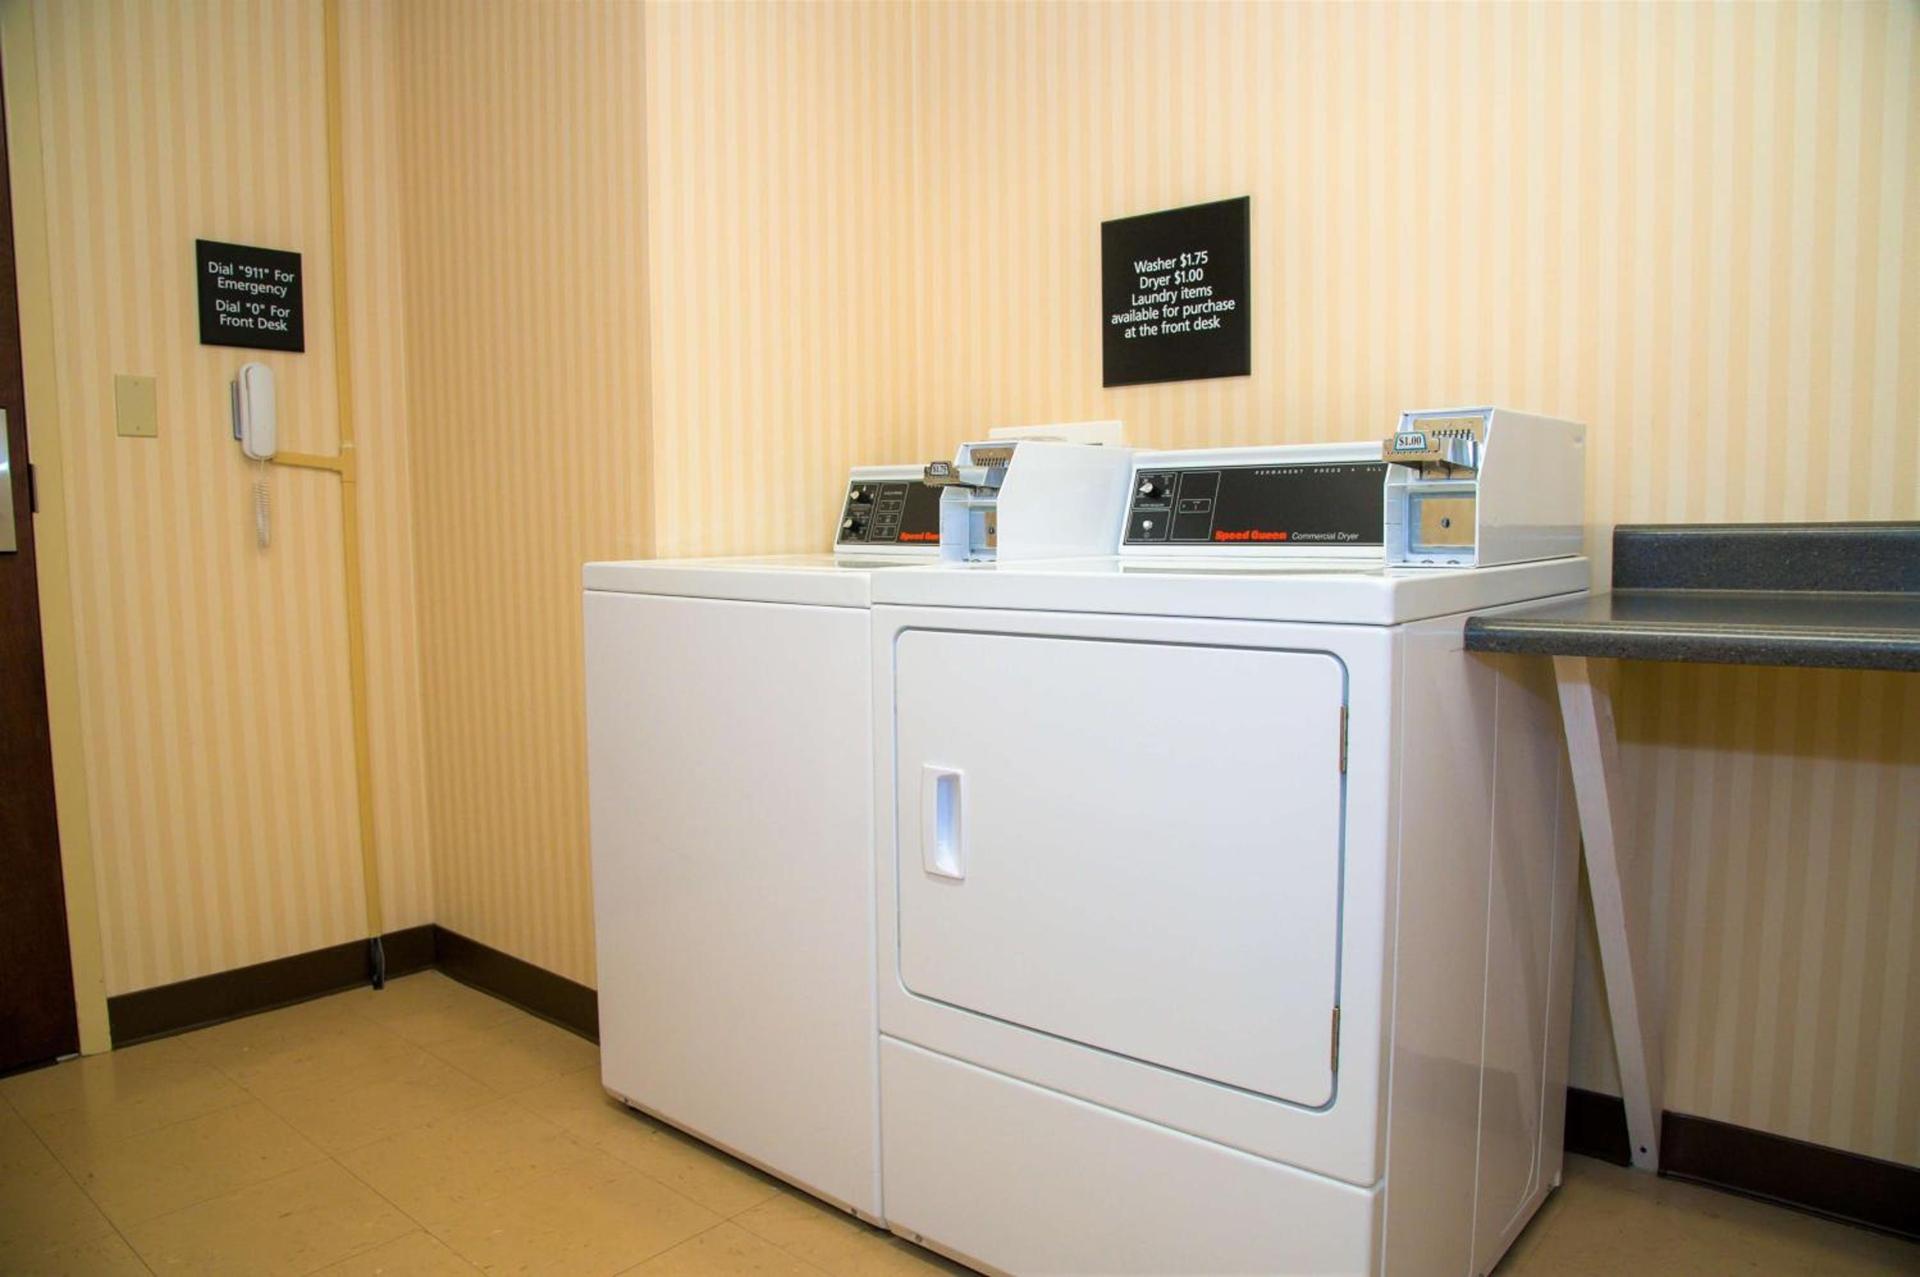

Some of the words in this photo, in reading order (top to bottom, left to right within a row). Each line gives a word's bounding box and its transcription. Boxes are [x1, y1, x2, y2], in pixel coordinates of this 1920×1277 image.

[208, 261, 234, 276] Dial
[238, 265, 270, 279] "911"
[274, 269, 295, 283] For
[1134, 257, 1177, 274] Washer
[1180, 250, 1208, 269] $1.75
[217, 277, 287, 298] Emergency
[1139, 275, 1170, 291] Dryer
[1174, 268, 1204, 286] $1.00
[1132, 289, 1177, 306] Laundry
[1181, 285, 1213, 300] items
[215, 299, 241, 313] Dial
[246, 302, 266, 315] "0"
[270, 306, 291, 318] For
[1111, 307, 1159, 325] available
[1162, 304, 1178, 318] for
[1182, 299, 1235, 318] purchase
[219, 314, 255, 328] Front
[258, 318, 288, 331] Desk
[1124, 327, 1136, 339] at
[1139, 323, 1158, 336] the
[1161, 319, 1190, 334] front
[1193, 315, 1221, 330] desk
[1398, 436, 1422, 447] $1.00
[1215, 530, 1250, 541] Speed
[1251, 530, 1287, 541] Queen
[1291, 531, 1336, 541] Commercial
[1337, 532, 1359, 541] Dryer
